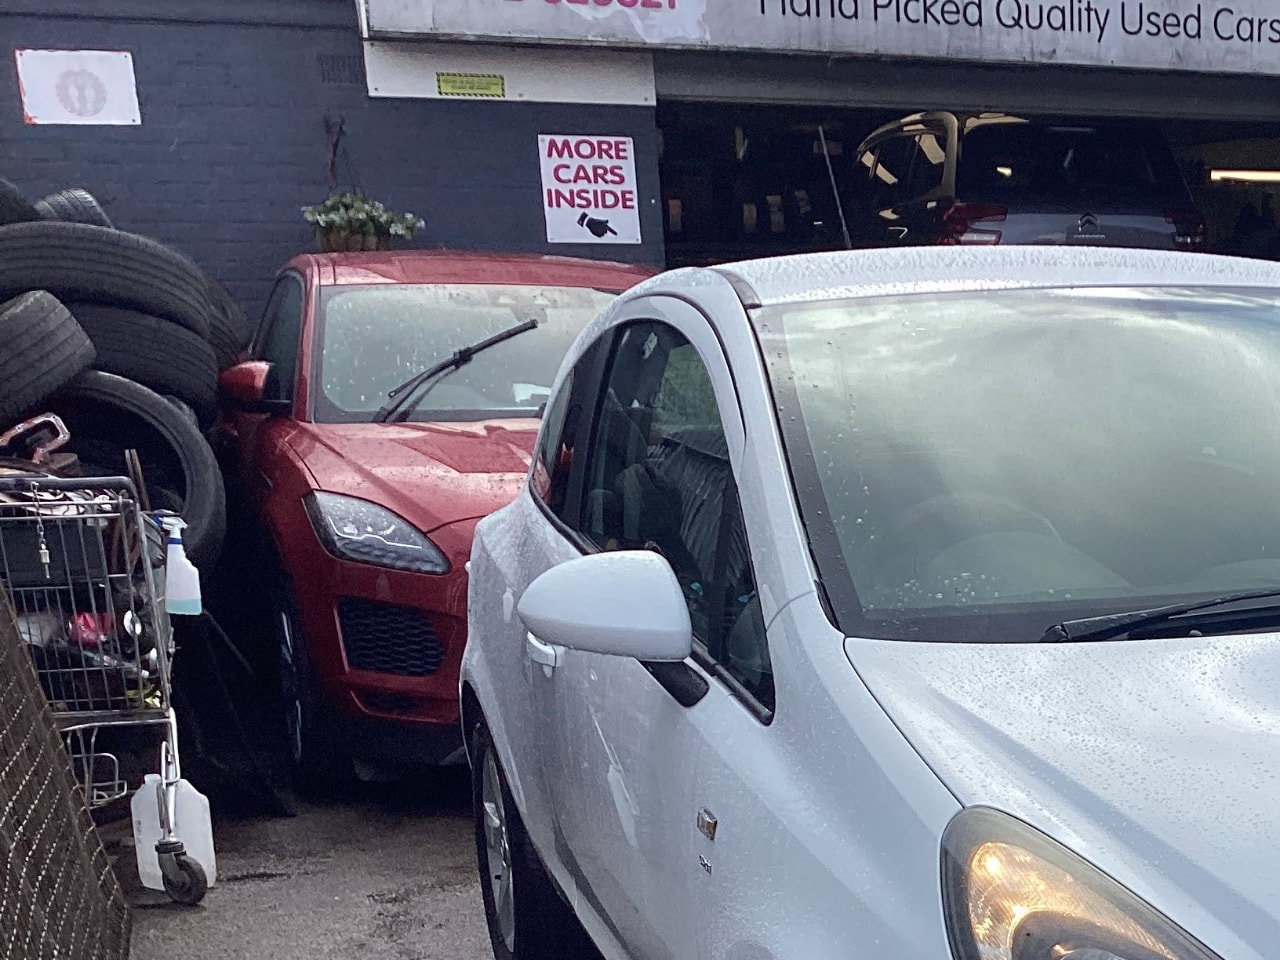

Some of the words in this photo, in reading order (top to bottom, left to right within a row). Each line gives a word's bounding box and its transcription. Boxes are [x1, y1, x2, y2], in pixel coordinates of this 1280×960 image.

[873, 0, 983, 28] Picked
[995, 0, 1110, 43] Quality
[1120, 1, 1202, 39] Used
[547, 138, 628, 160] MORE
[553, 163, 625, 185] CARS
[546, 188, 635, 209] INSIDE
